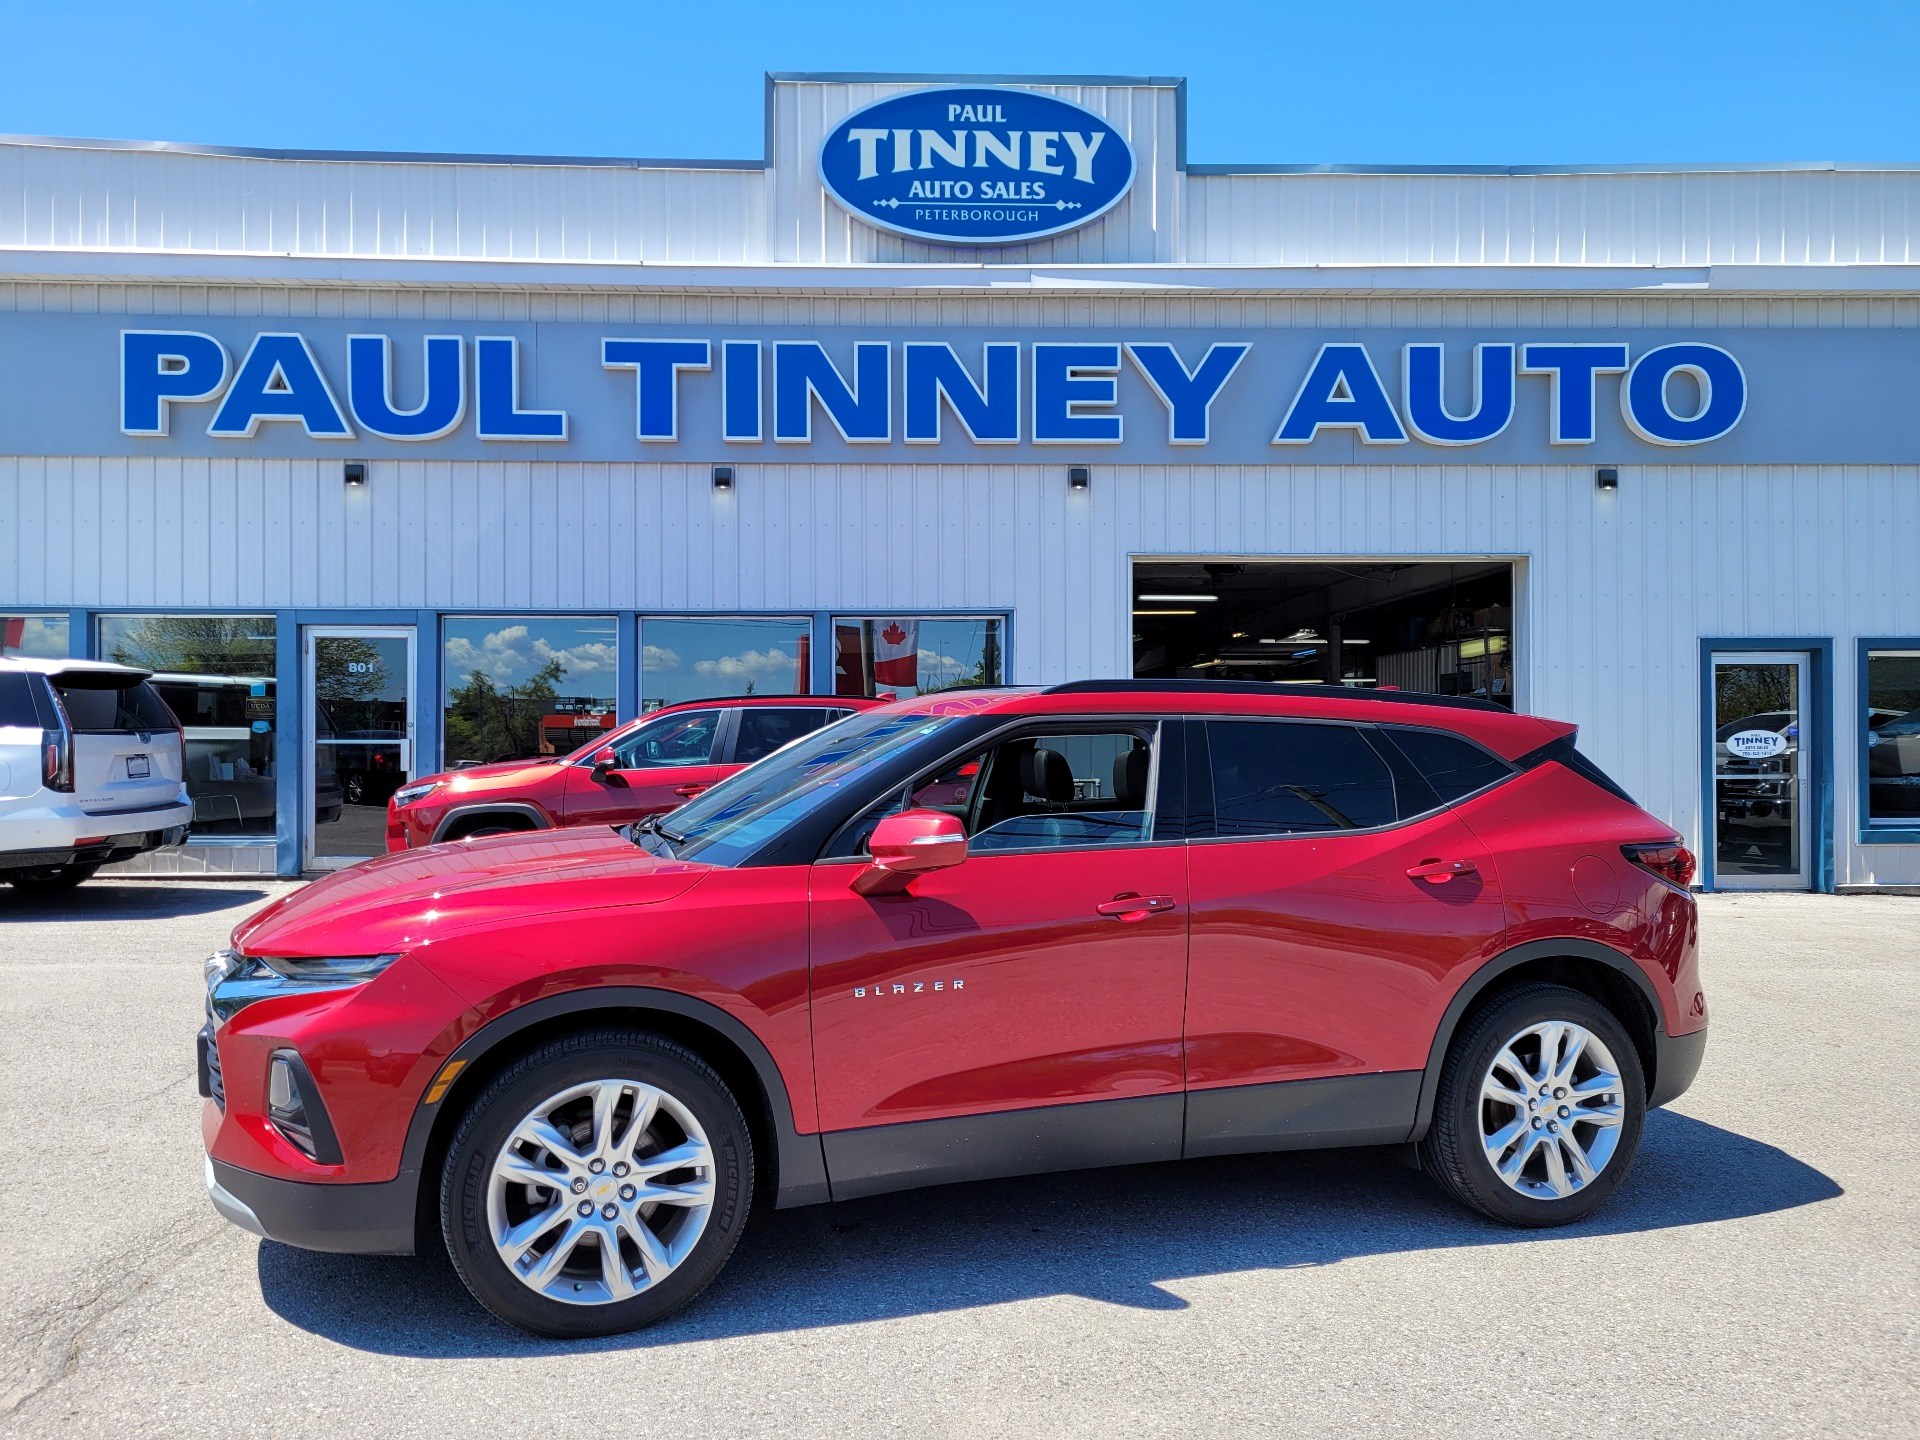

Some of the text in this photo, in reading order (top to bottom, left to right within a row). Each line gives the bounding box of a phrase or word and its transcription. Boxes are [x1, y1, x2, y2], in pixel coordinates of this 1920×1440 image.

[948, 104, 1007, 123] PAUL
[847, 128, 1106, 185] TINNEY
[908, 180, 1046, 200] AUTO SALES
[915, 209, 1039, 222] PETERBOROUGH
[119, 329, 1748, 447] PAUL TINNEY AUTO
[348, 662, 374, 673] 801
[1734, 737, 1778, 747] TINNEY
[853, 979, 965, 998] BLAZER
[719, 1143, 739, 1232] MICHELIN
